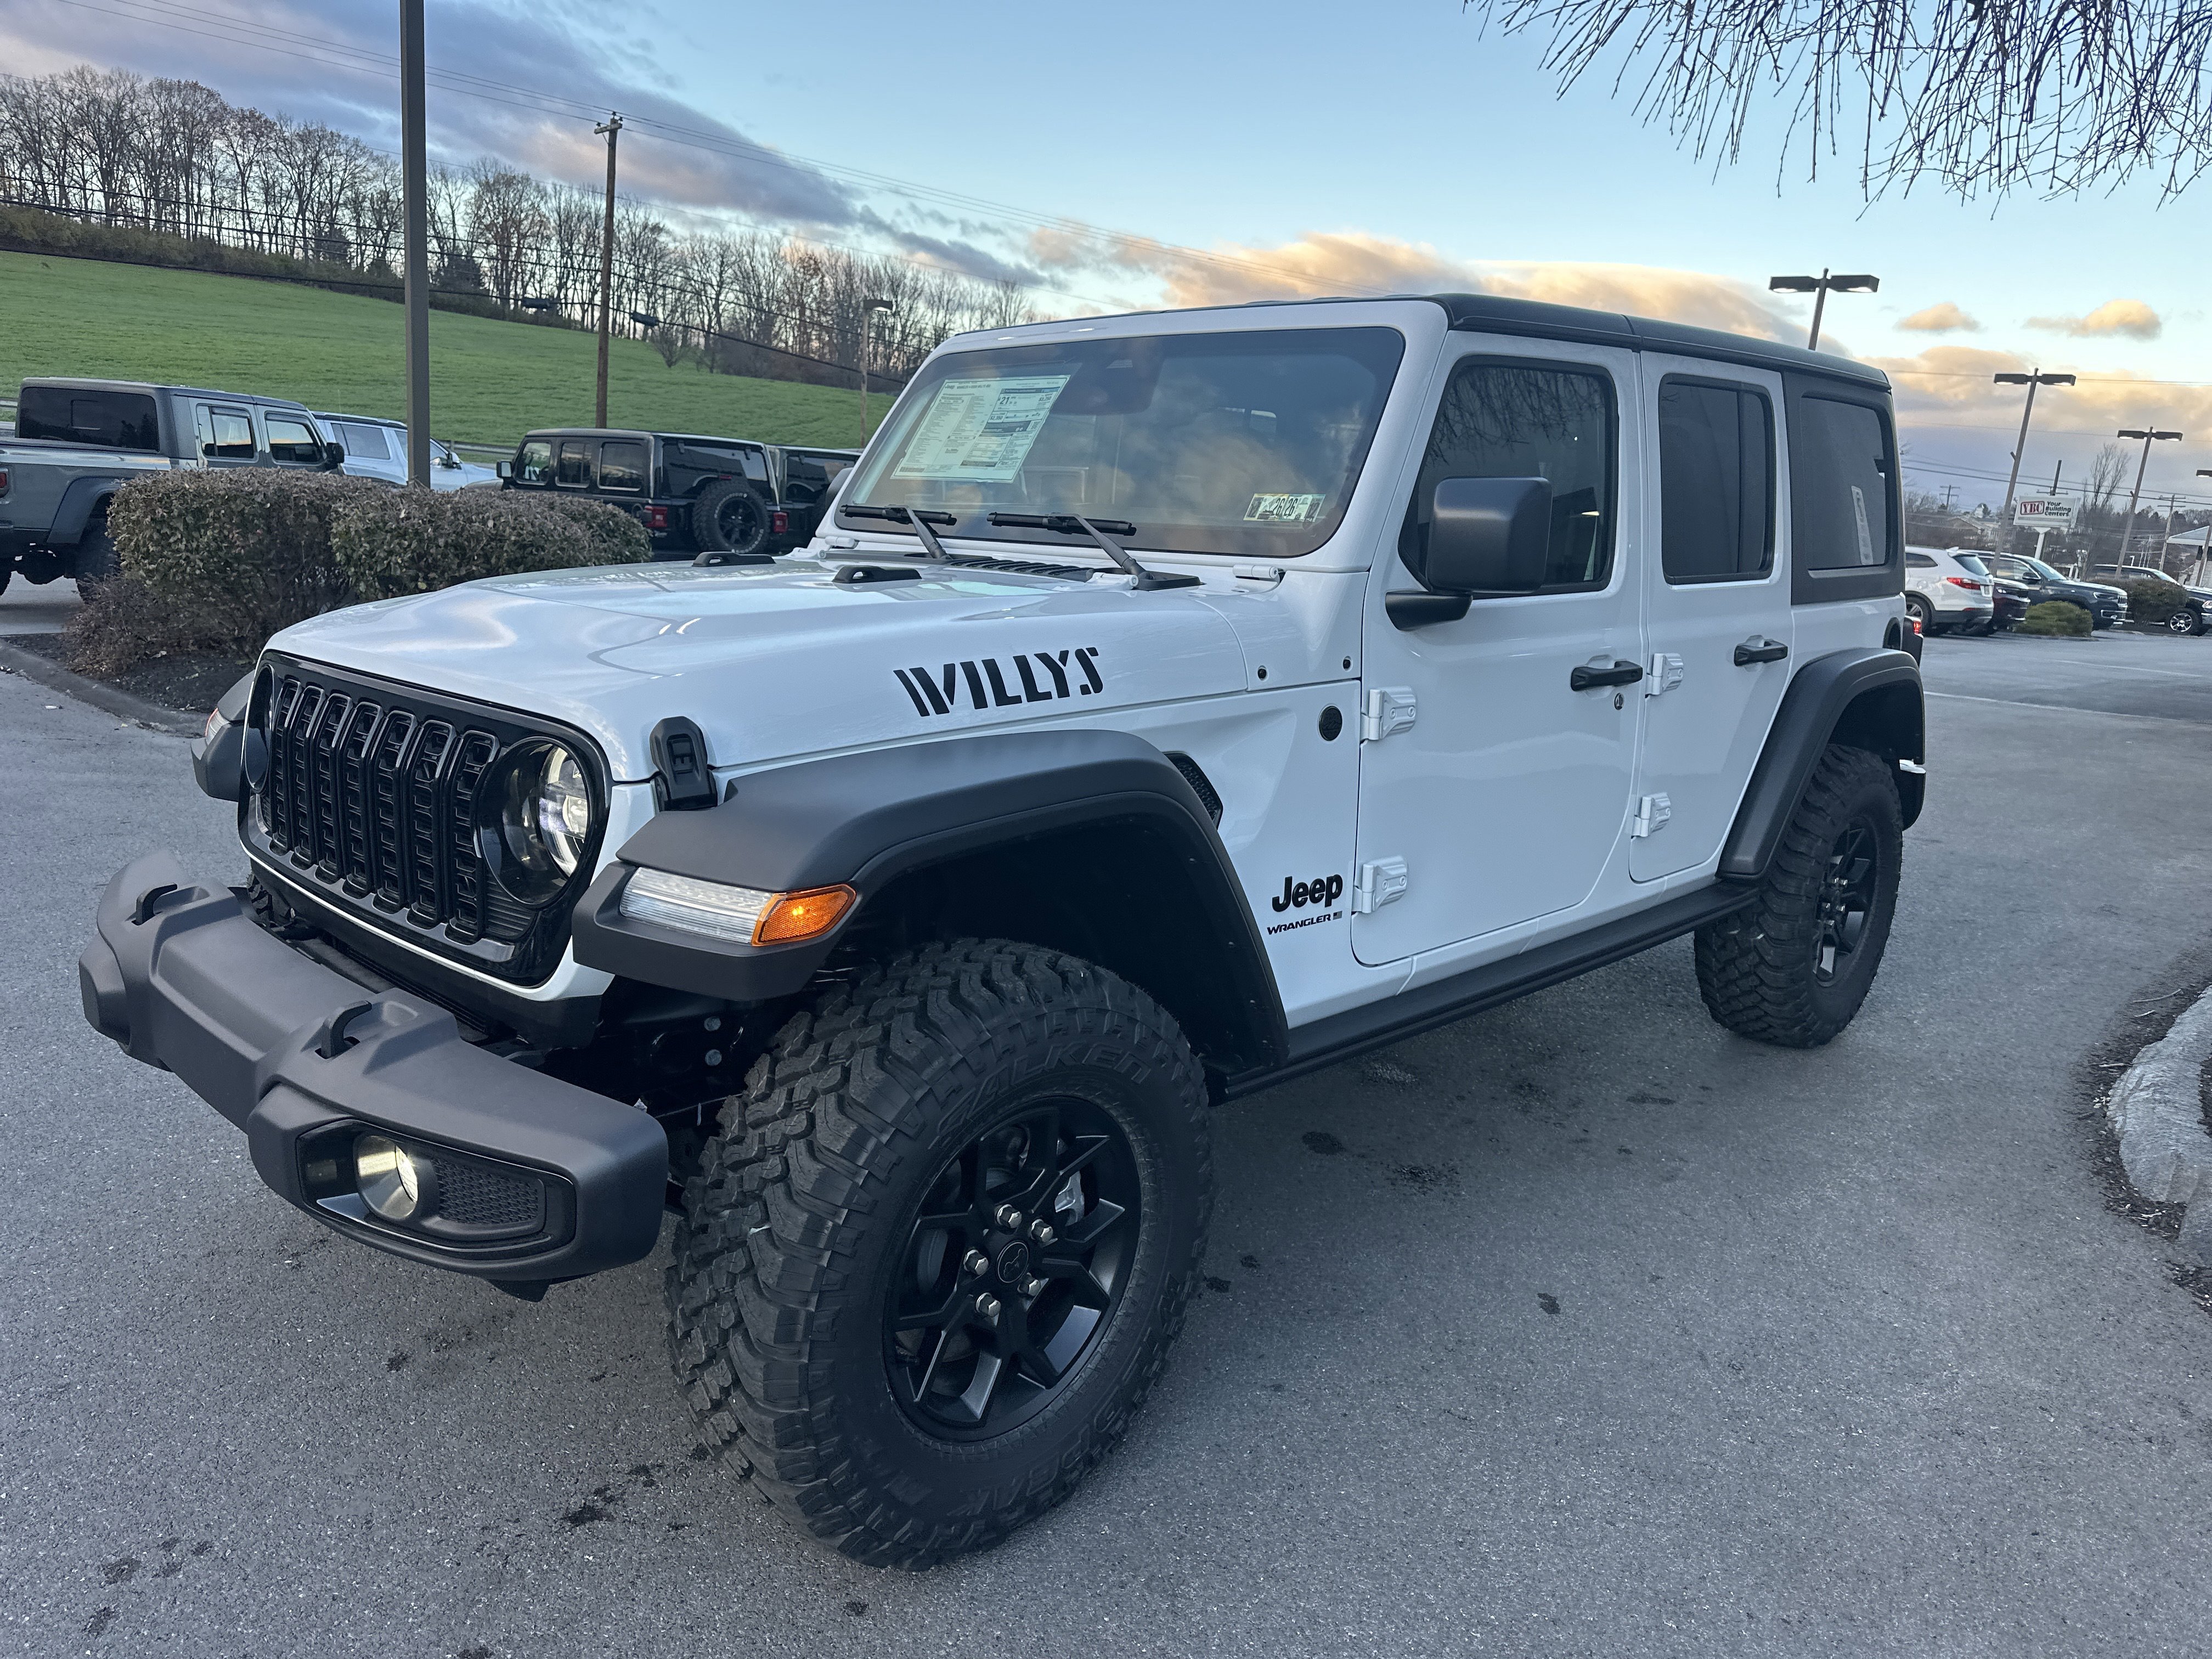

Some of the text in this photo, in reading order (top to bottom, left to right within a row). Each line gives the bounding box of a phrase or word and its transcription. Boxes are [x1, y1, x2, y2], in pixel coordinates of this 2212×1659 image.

[1000, 397, 1009, 405] 21
[1284, 498, 1299, 517] 26
[2023, 503, 2043, 514] YBC
[893, 647, 1104, 717] WILLYS
[1272, 874, 1343, 912] Jeep
[1267, 913, 1331, 935] WRANGLER
